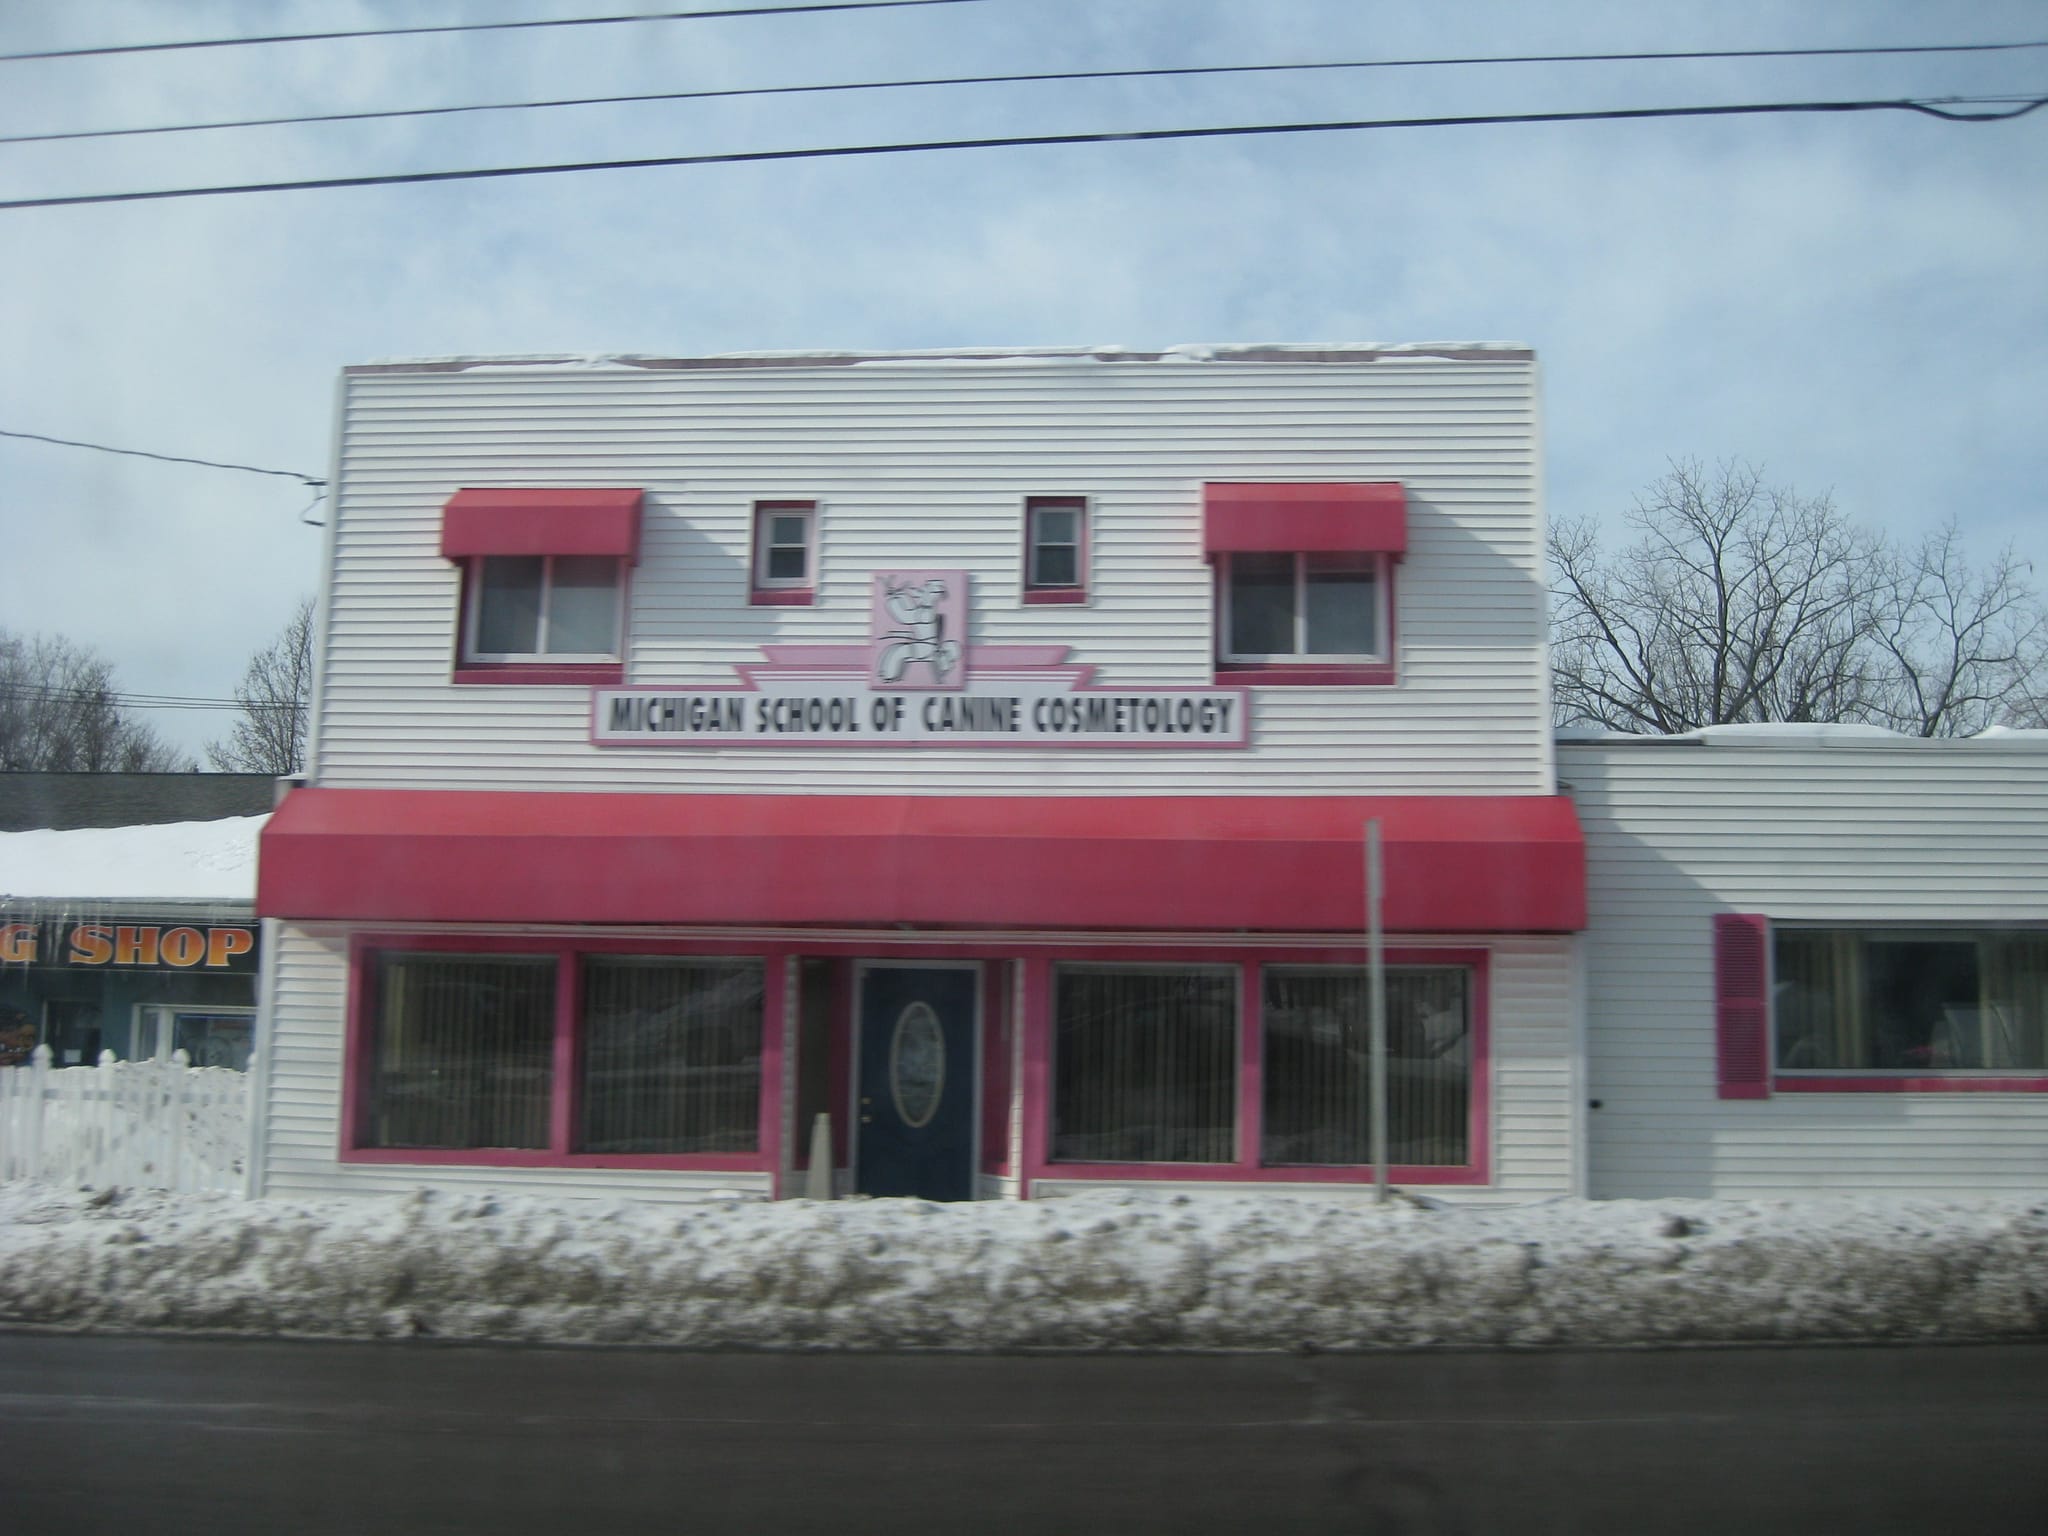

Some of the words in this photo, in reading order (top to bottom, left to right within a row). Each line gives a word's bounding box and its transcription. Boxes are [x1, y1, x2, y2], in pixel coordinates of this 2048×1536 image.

[609, 697, 745, 731] MICHIGAN
[757, 697, 859, 732] SCHOOL
[871, 697, 905, 732] OF
[922, 697, 1020, 731] CANINE
[1032, 697, 1235, 732] COSMETOLOGY
[70, 925, 254, 967] SHOP
